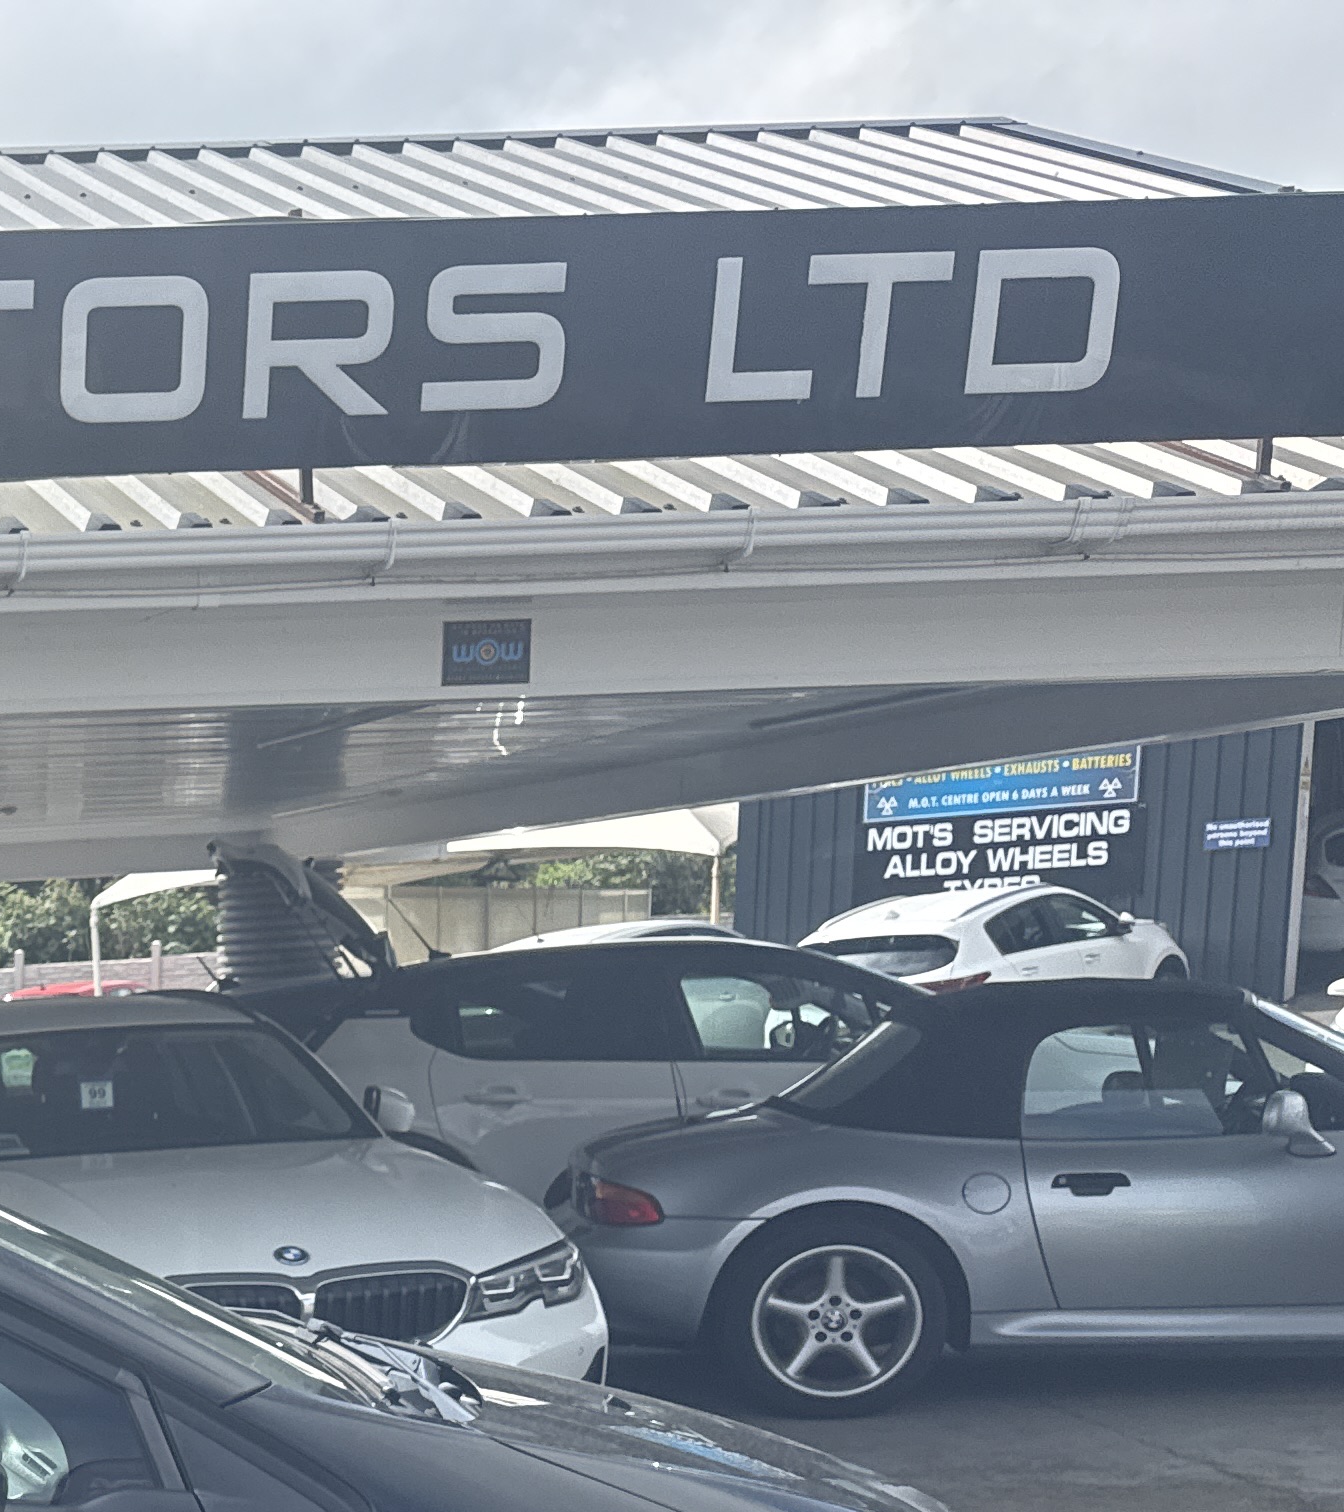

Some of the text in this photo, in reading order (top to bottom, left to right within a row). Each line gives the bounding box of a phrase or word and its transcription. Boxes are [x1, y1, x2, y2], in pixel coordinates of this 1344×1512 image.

[705, 246, 1121, 403] LTD
[951, 767, 992, 781] WHEELS
[1003, 759, 1060, 777] EXHAUSTS
[1072, 753, 1132, 771] BATTERIES
[941, 793, 979, 806] CENTRE
[981, 789, 1010, 803] OPEN
[1012, 788, 1019, 801] 6
[1021, 786, 1048, 800] DAYS
[1050, 785, 1059, 798] A
[1061, 783, 1090, 797] WEEK
[867, 809, 1130, 851] MOT'S SERVICING
[883, 841, 1108, 879] ALLOY WHEELS
